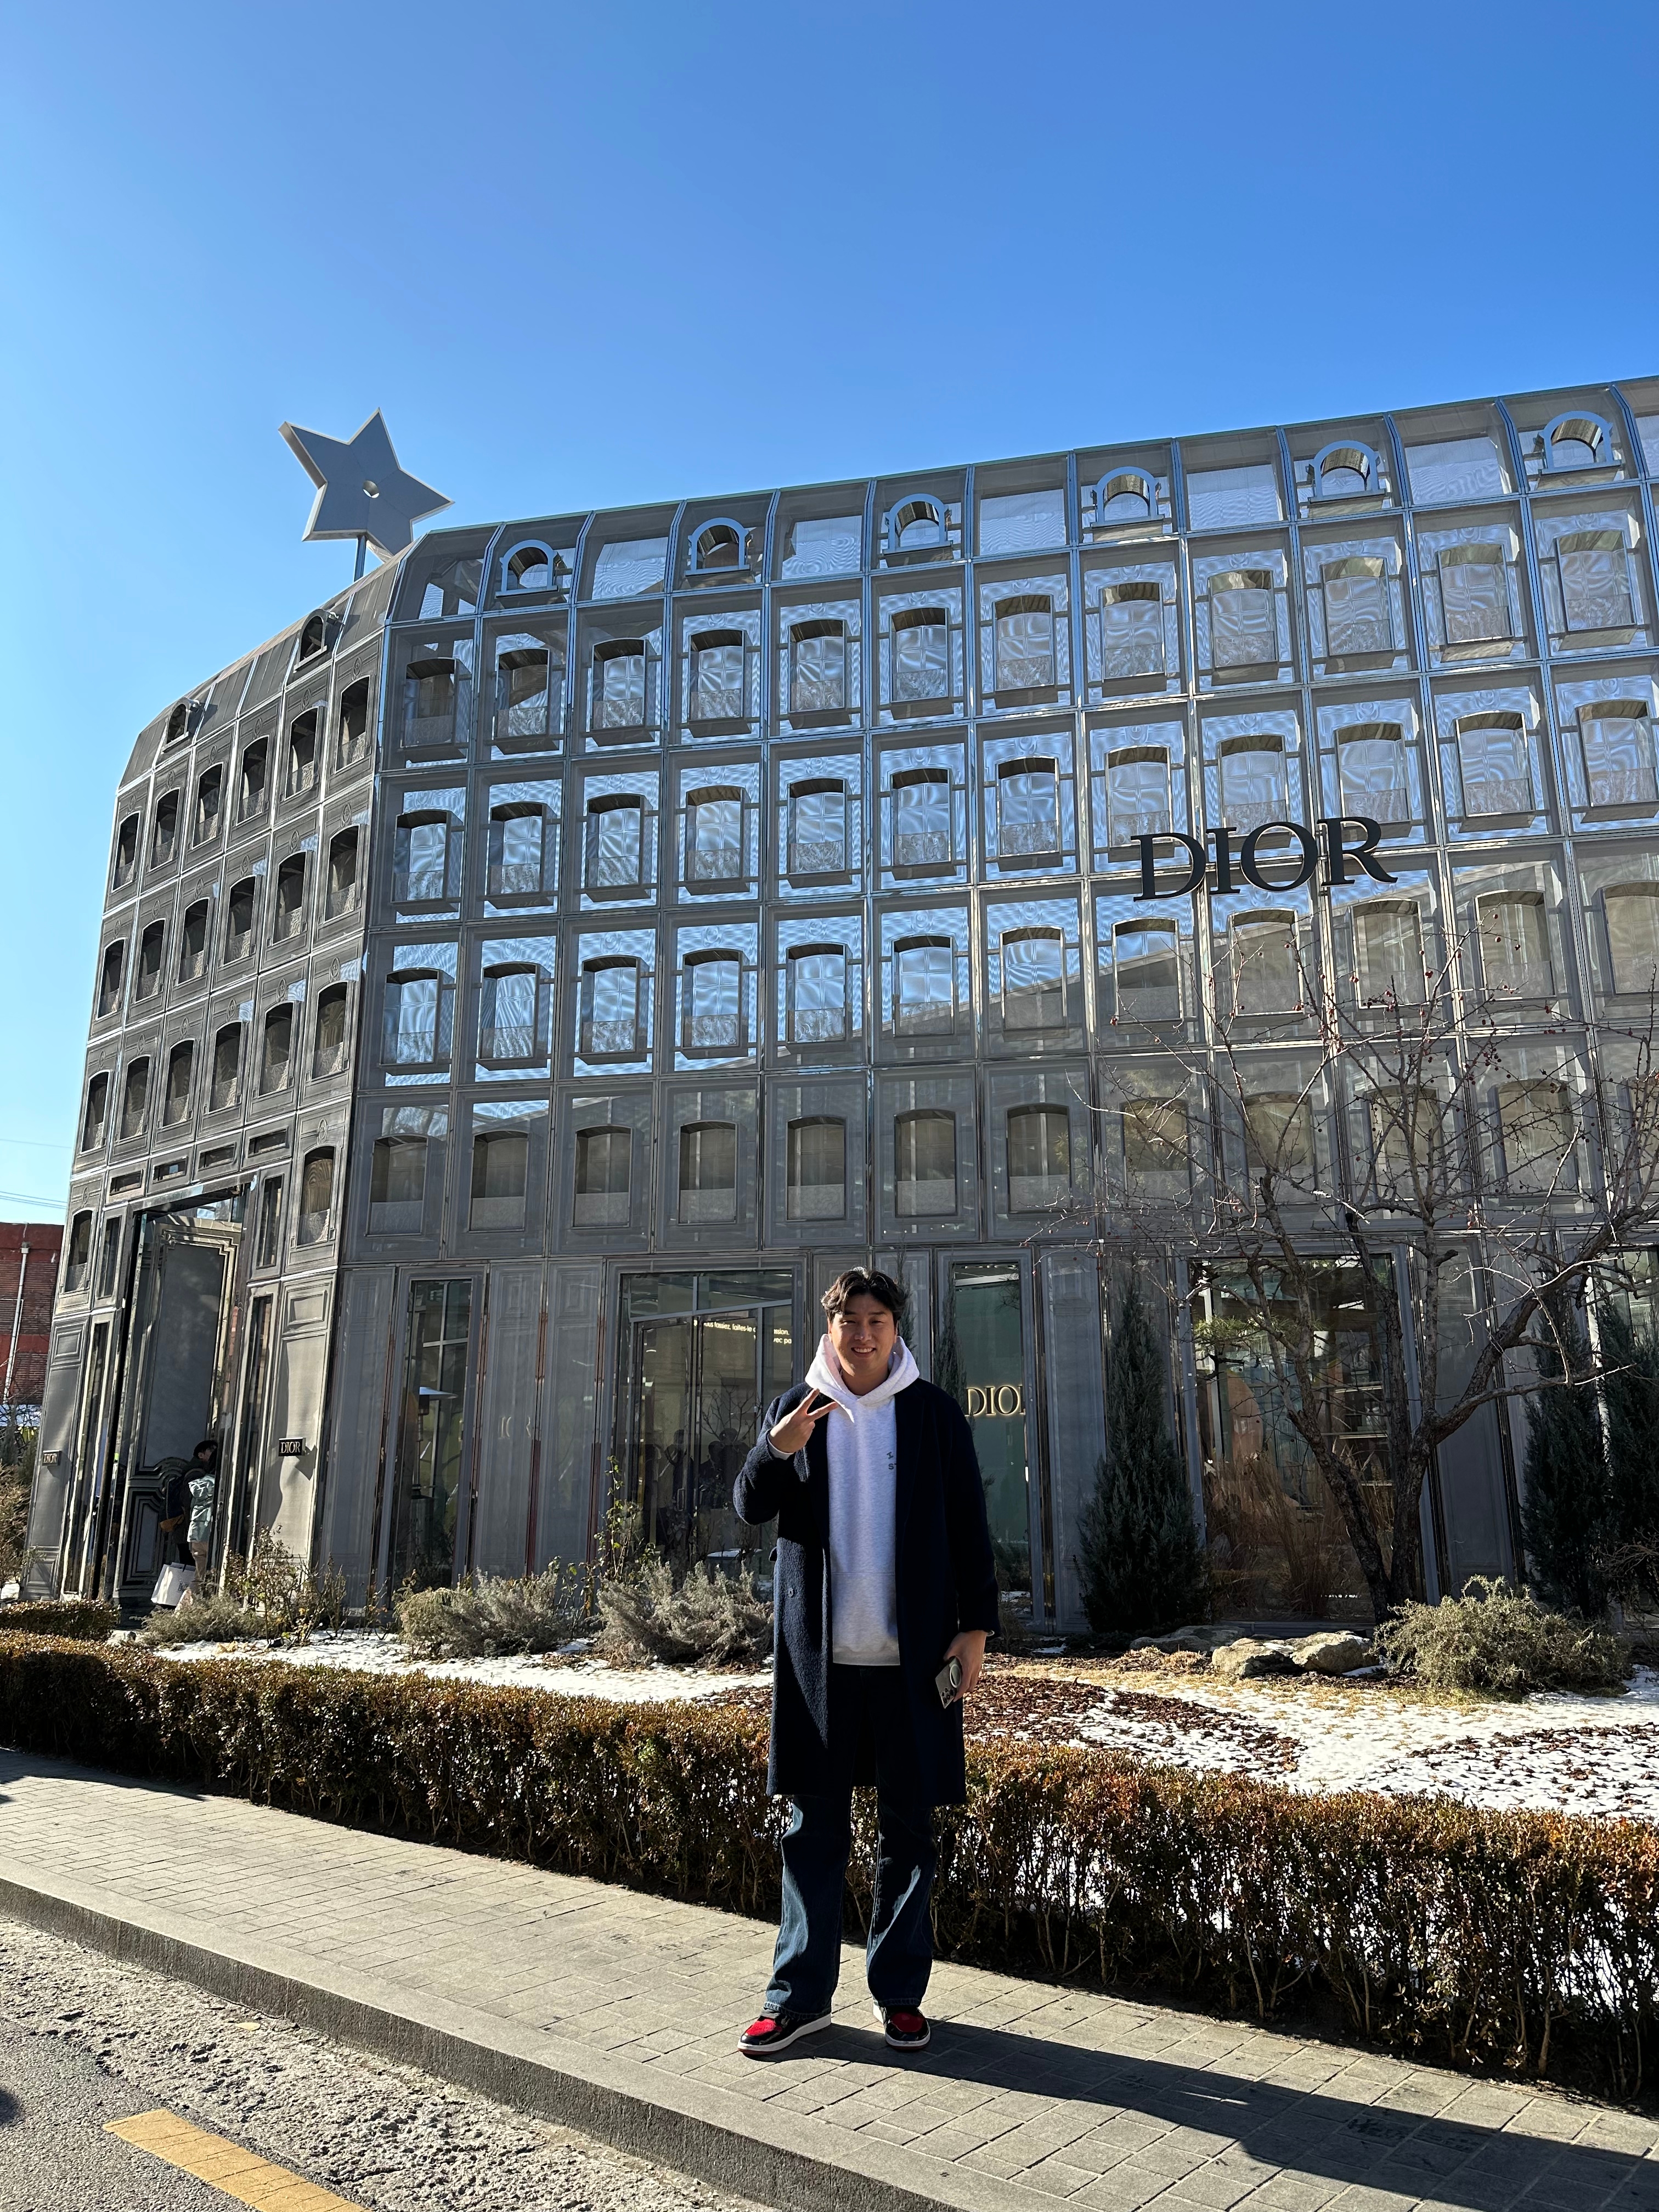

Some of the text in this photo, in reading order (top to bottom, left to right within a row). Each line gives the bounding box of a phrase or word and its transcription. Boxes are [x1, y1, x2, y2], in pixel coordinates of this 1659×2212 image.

[1131, 816, 1398, 902] DIOR
[280, 1441, 301, 1453] DIOR
[44, 1453, 57, 1463] DIOR
